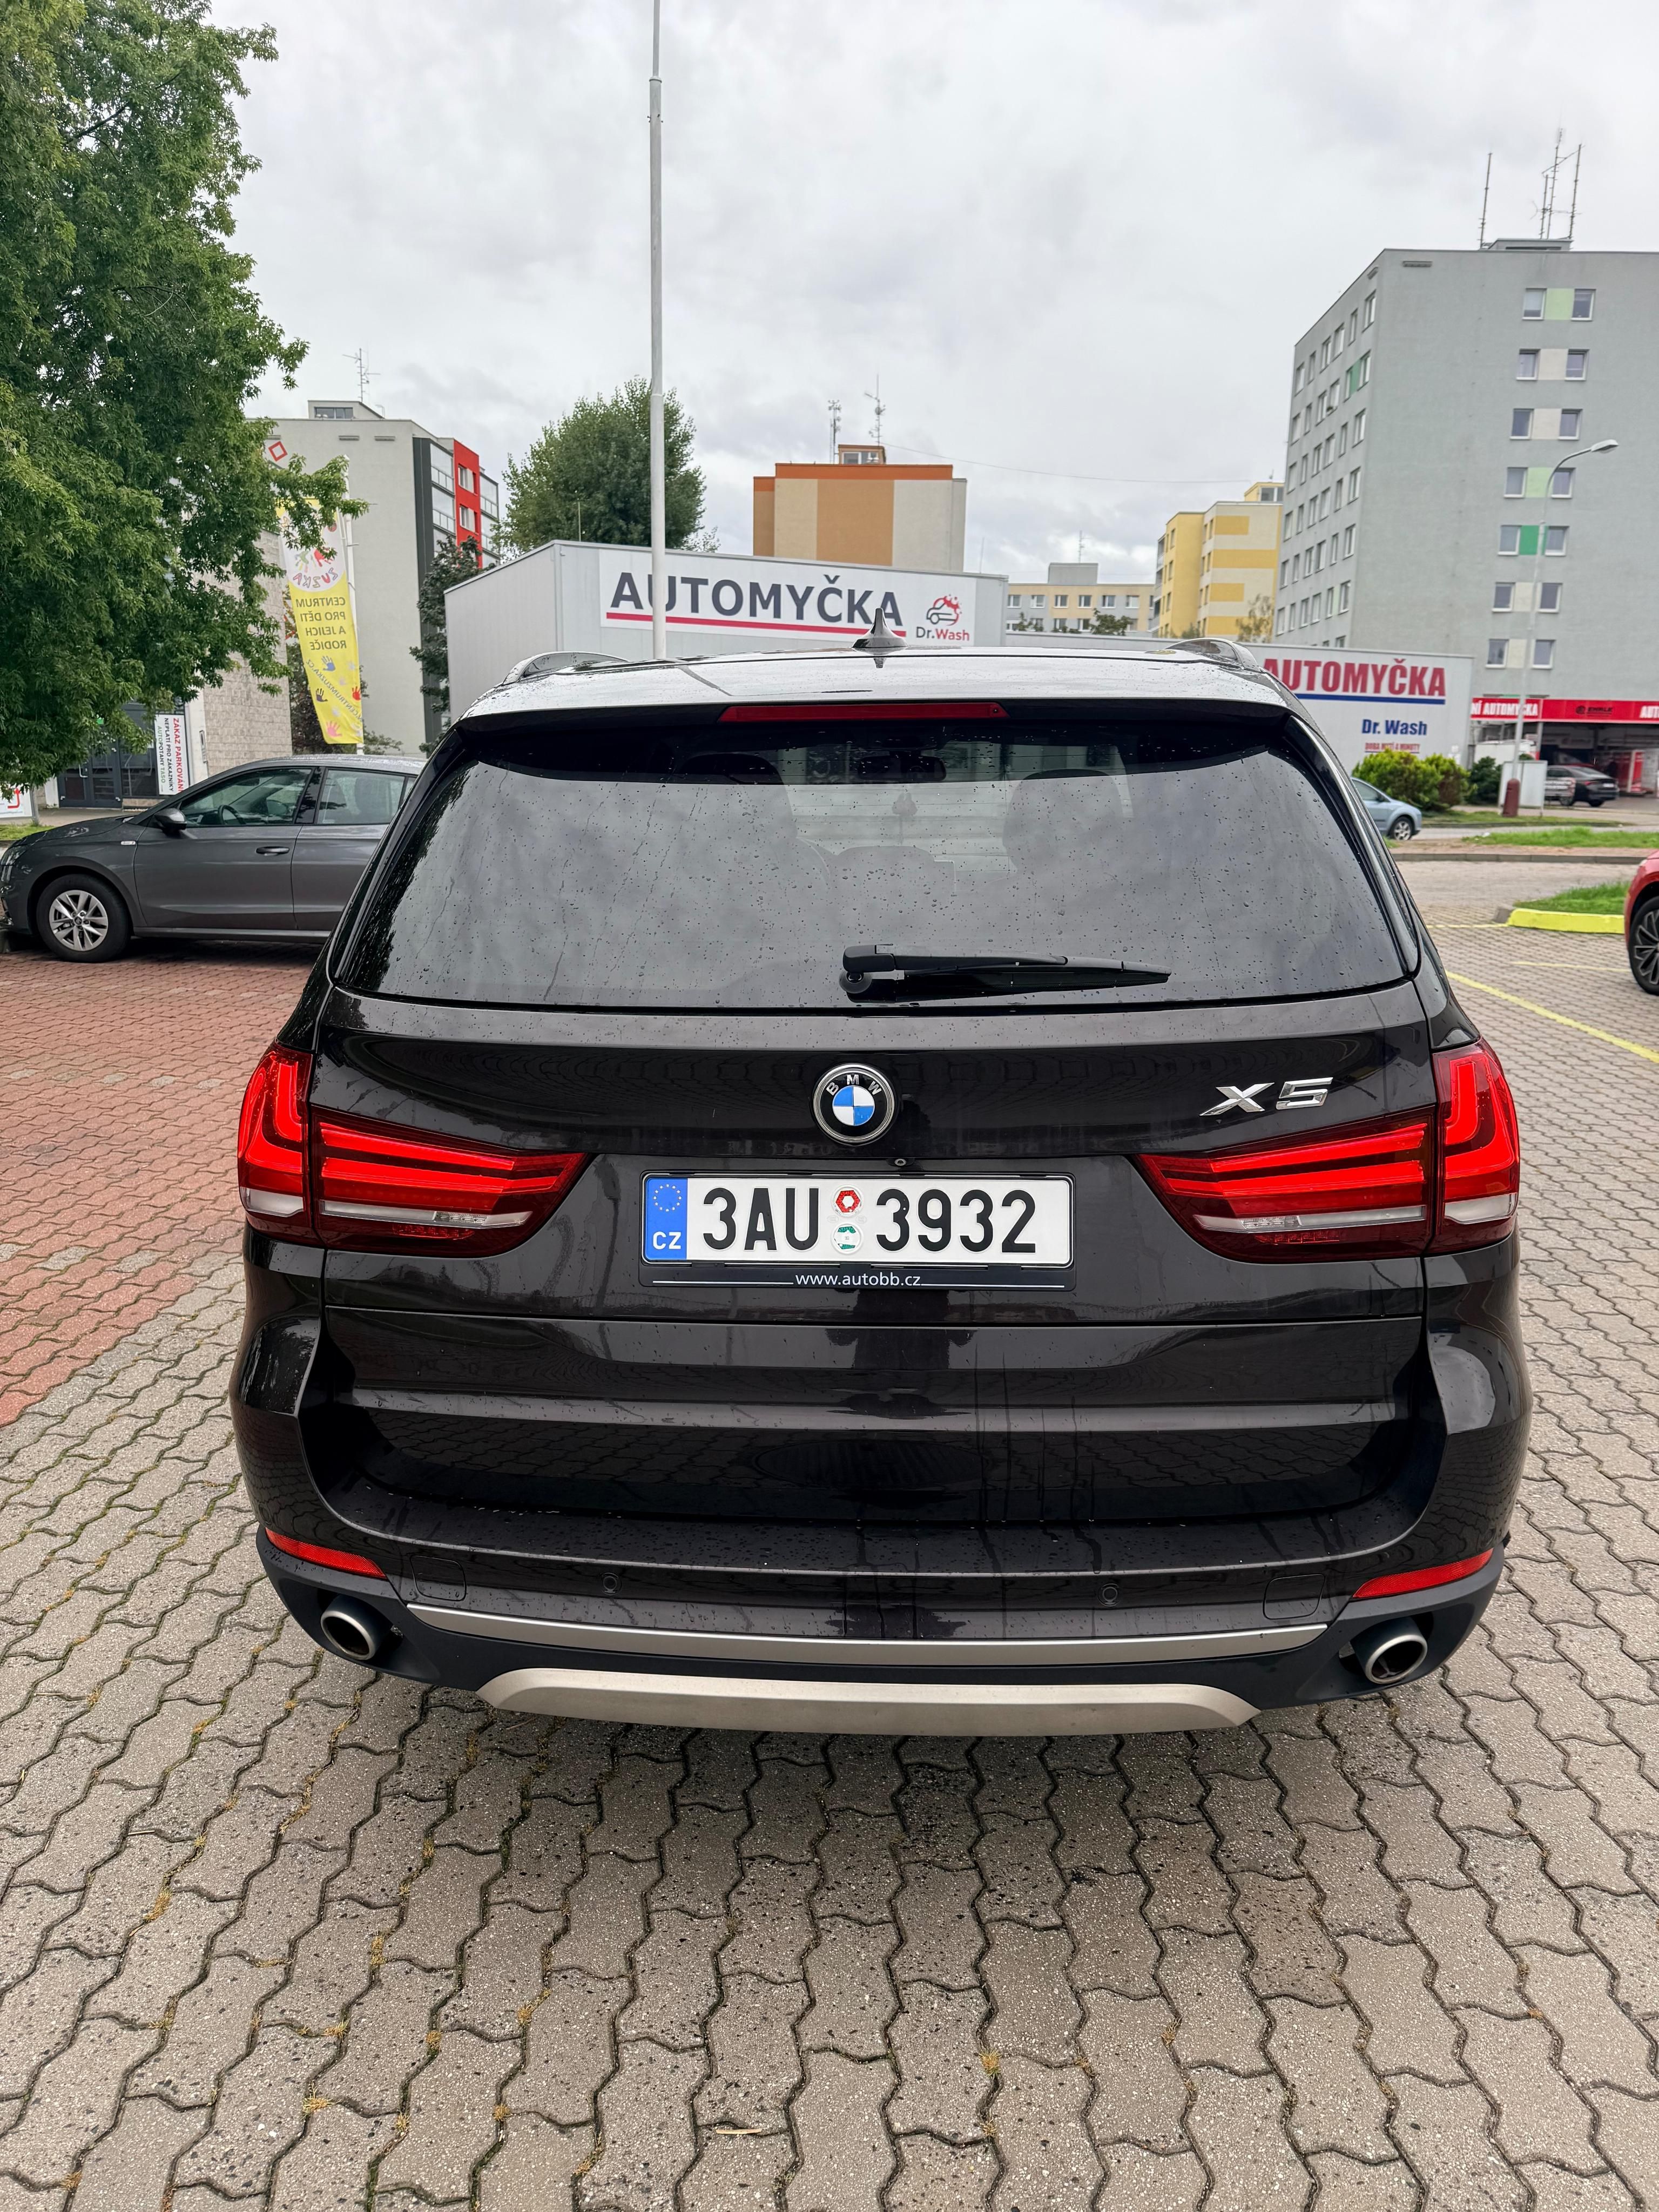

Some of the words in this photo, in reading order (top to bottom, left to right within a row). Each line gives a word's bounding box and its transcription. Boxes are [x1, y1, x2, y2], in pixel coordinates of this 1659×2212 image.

[610, 572, 903, 626] AUTOMYČKA
[916, 626, 970, 641] Dr.Wash
[1361, 719, 1381, 734] Dr.
[1385, 720, 1427, 736] Wash
[826, 1074, 882, 1096] BMW
[1199, 1077, 1333, 1116] X5
[703, 1188, 819, 1251] 3AU
[876, 1189, 1036, 1253] 3932
[652, 1231, 682, 1250] CZ
[795, 1272, 921, 1286] www.autobb.cz
